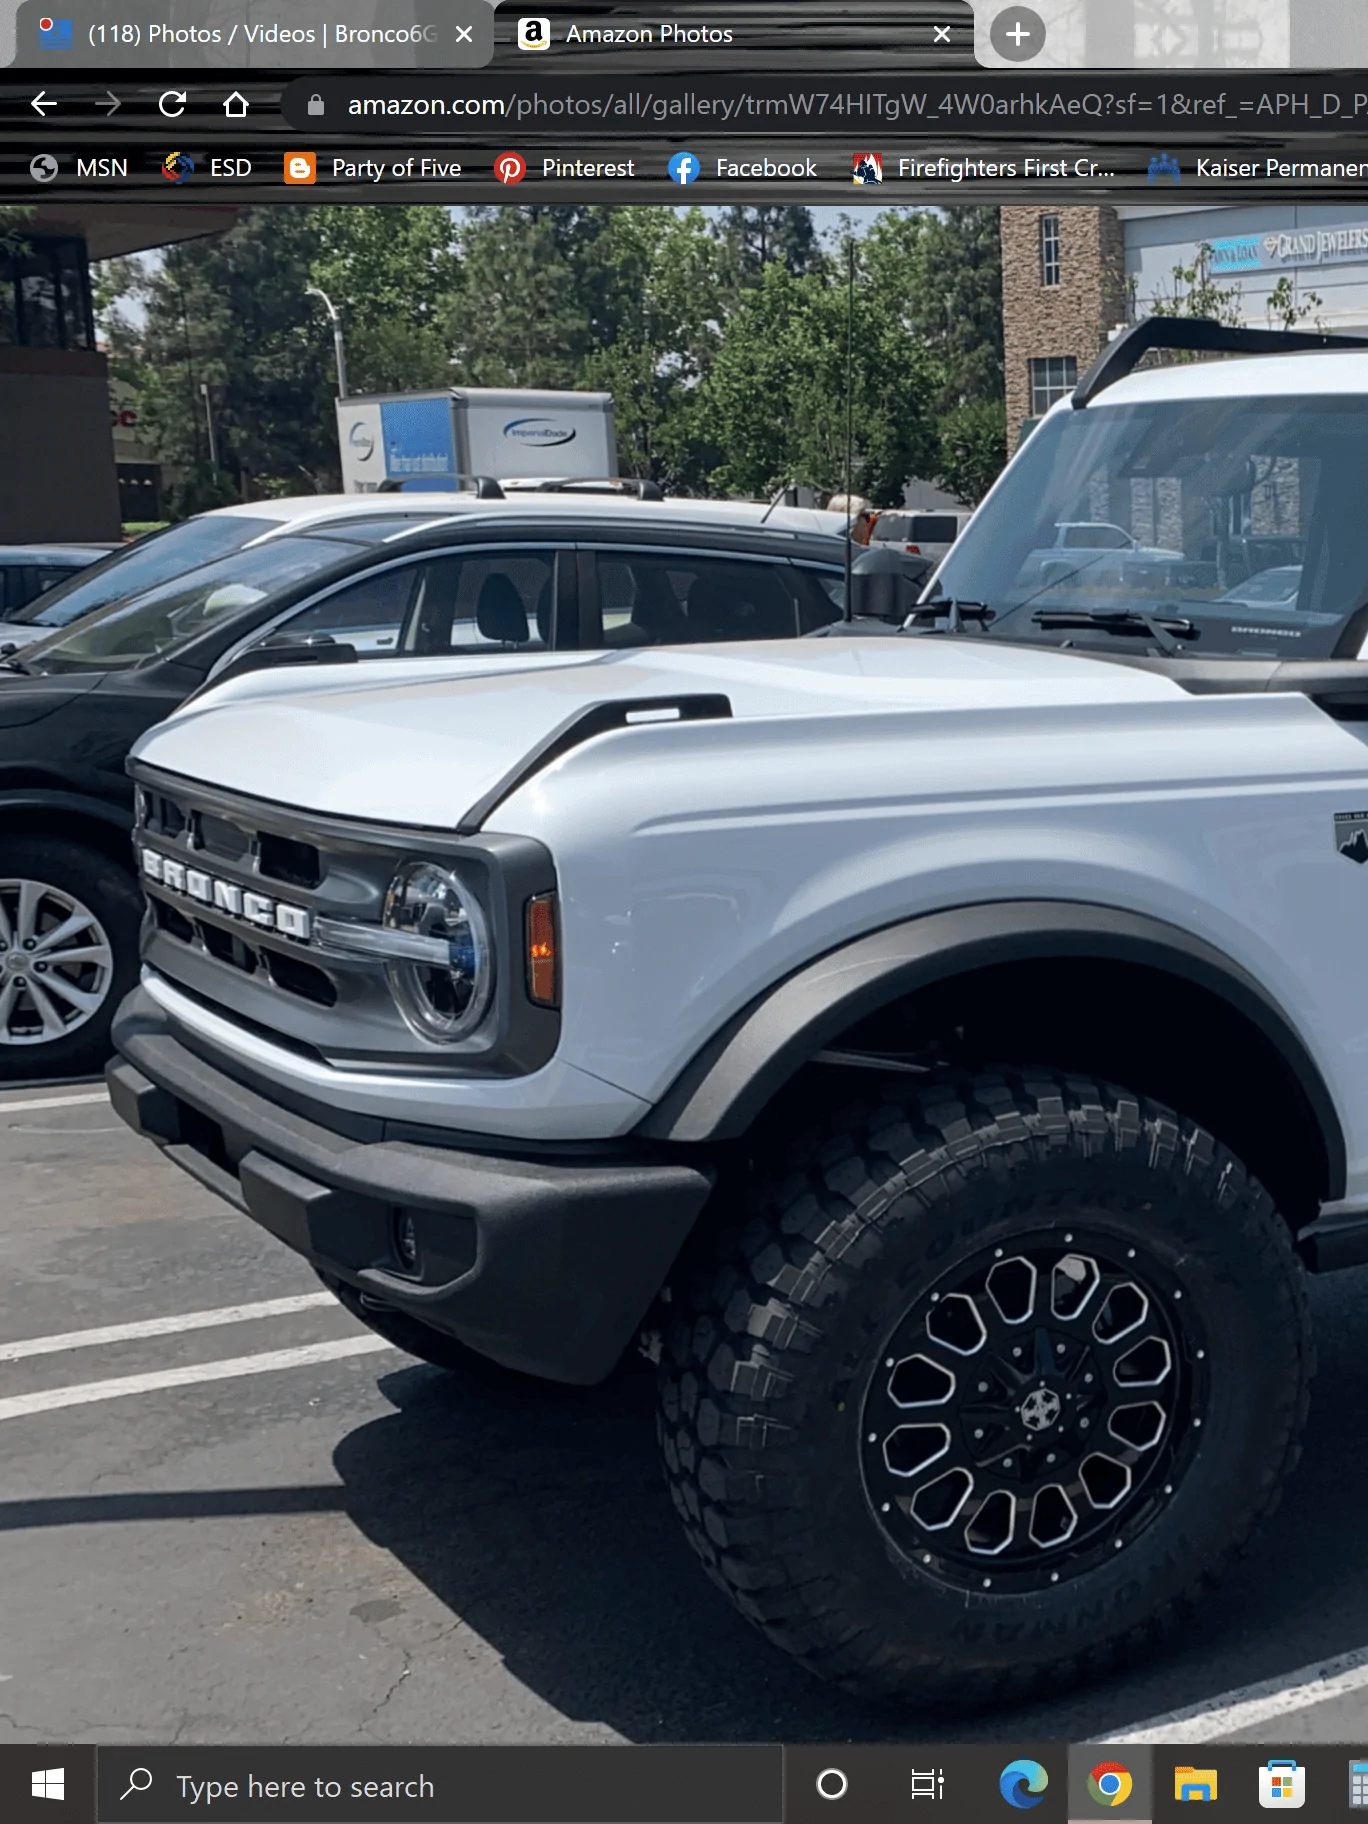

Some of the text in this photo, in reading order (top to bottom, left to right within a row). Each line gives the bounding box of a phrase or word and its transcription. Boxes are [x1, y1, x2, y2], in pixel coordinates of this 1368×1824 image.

[88, 23, 141, 47] (118)
[149, 23, 222, 43] Photos
[243, 23, 316, 43] Videos
[335, 23, 438, 43] Bronco6G
[565, 23, 733, 43] Amazon Photos
[77, 158, 127, 177] MSN
[211, 158, 252, 177] ESD
[333, 157, 462, 183] Party of Five
[543, 158, 635, 177] Pinterest
[717, 157, 818, 177] Facebook
[899, 157, 1115, 183] Firefighters First Cr...
[1197, 158, 1260, 177] Kaiser
[142, 848, 310, 939] BRONCO
[176, 1773, 434, 1805] Type here to search
